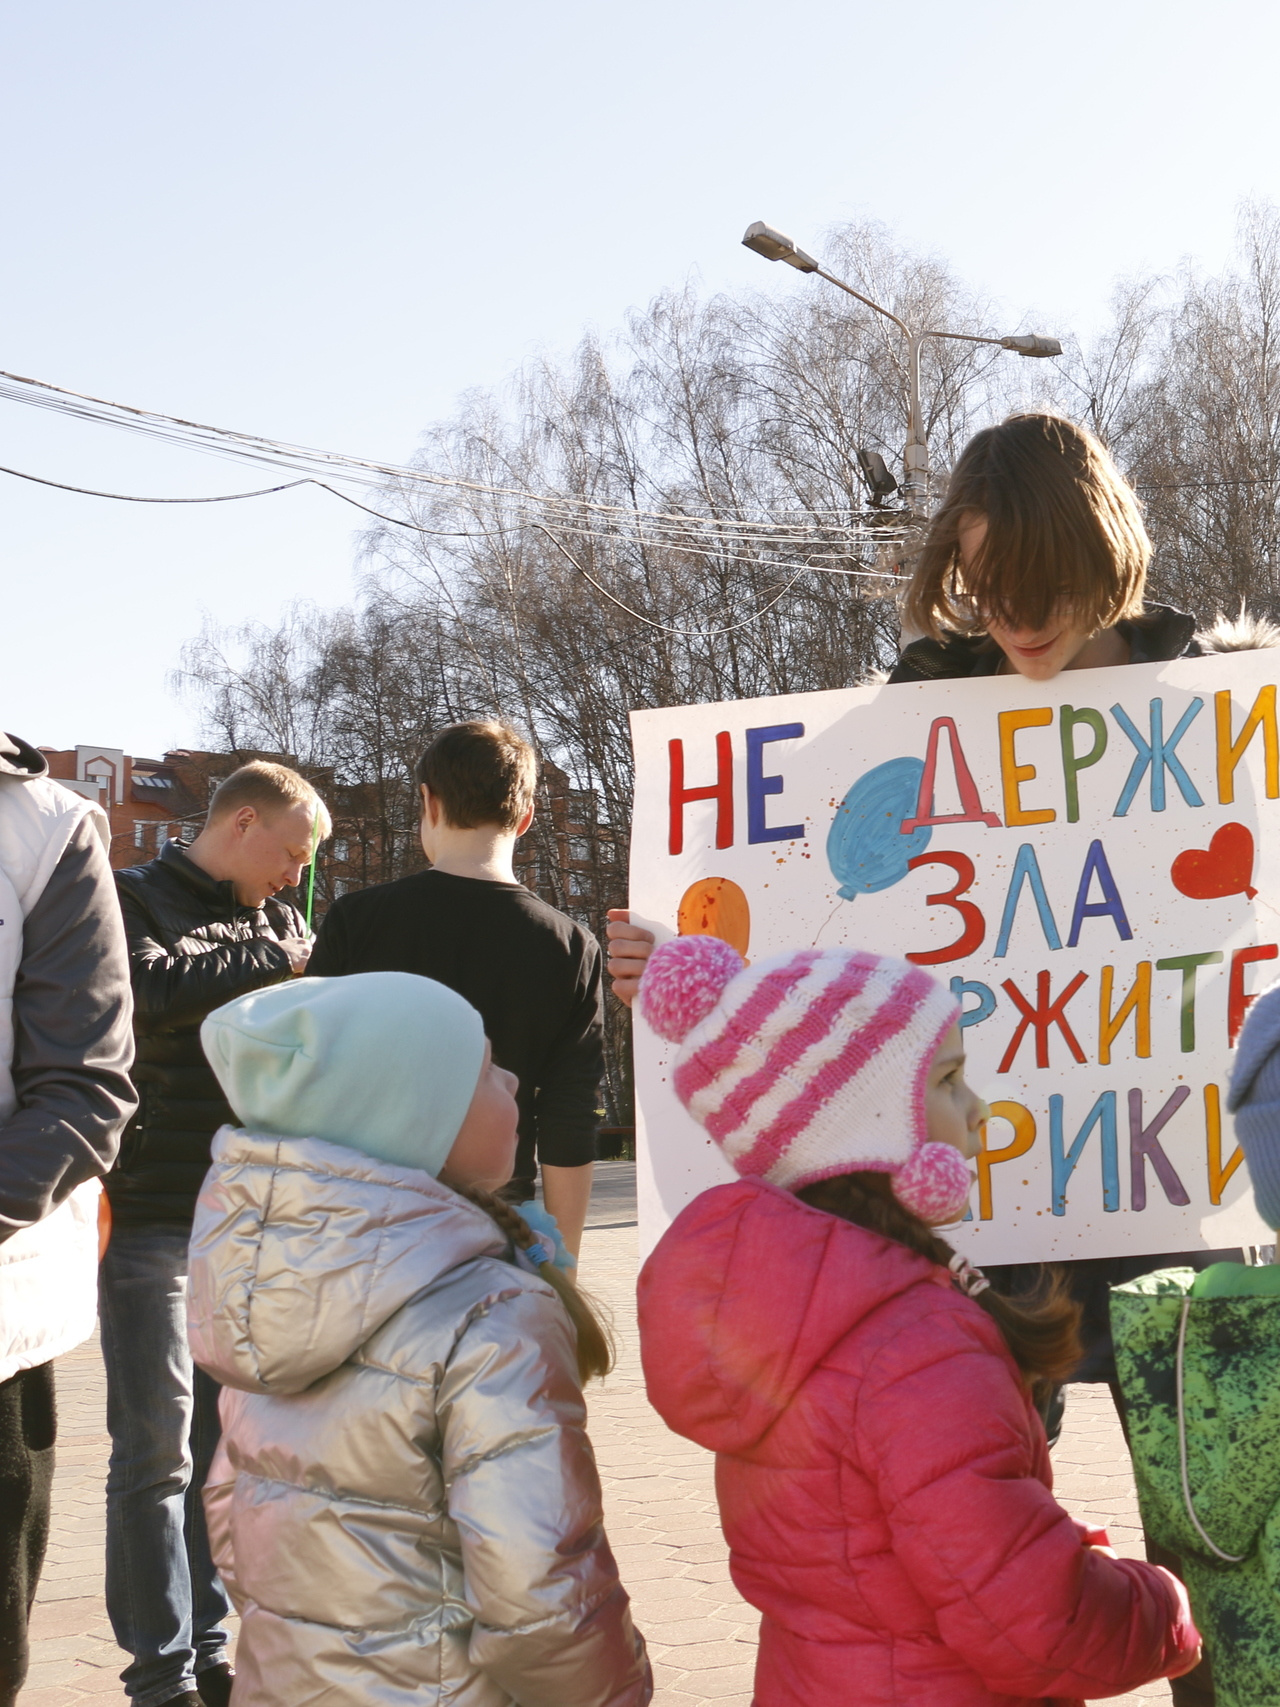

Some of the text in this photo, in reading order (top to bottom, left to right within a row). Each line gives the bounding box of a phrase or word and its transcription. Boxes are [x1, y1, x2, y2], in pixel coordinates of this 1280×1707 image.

[668, 722, 805, 855] НЕ
[906, 839, 1133, 965] ЗЛА
[949, 944, 1279, 1073] РЖИТЕ
[961, 1083, 1246, 1222] РИКИ
